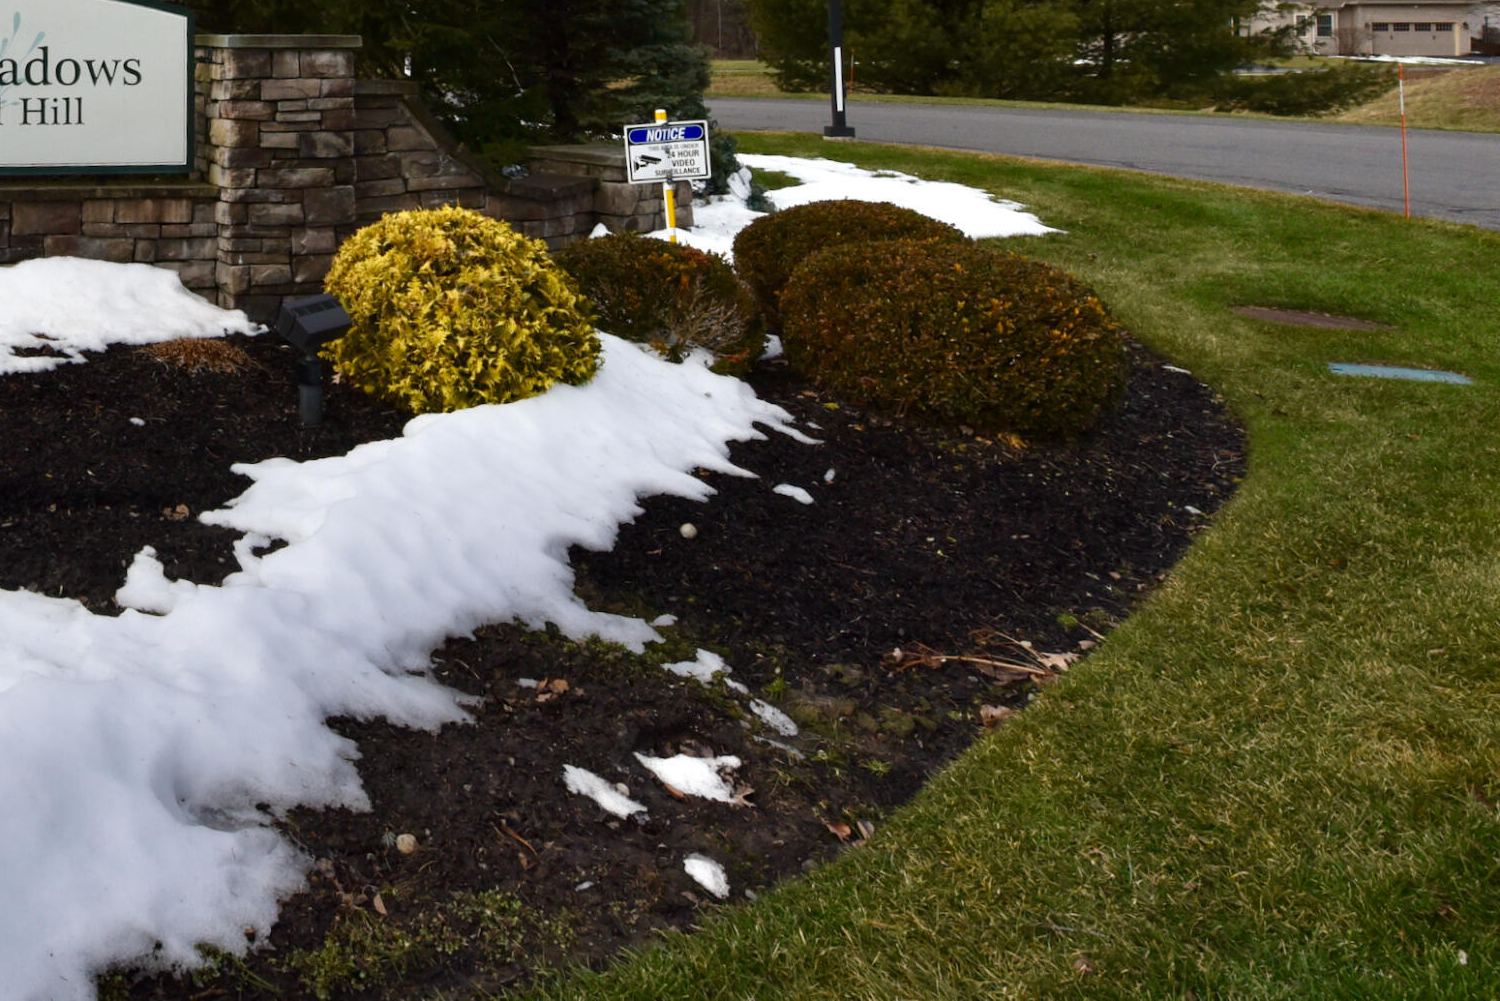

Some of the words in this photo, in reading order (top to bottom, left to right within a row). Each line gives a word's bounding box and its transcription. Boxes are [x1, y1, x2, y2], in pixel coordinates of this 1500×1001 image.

[19, 97, 85, 126] Hill
[646, 127, 686, 142] NOTICE
[677, 149, 700, 158] HOUR
[672, 158, 695, 167] VIDEO
[655, 166, 701, 176] SURVEILLANCE
